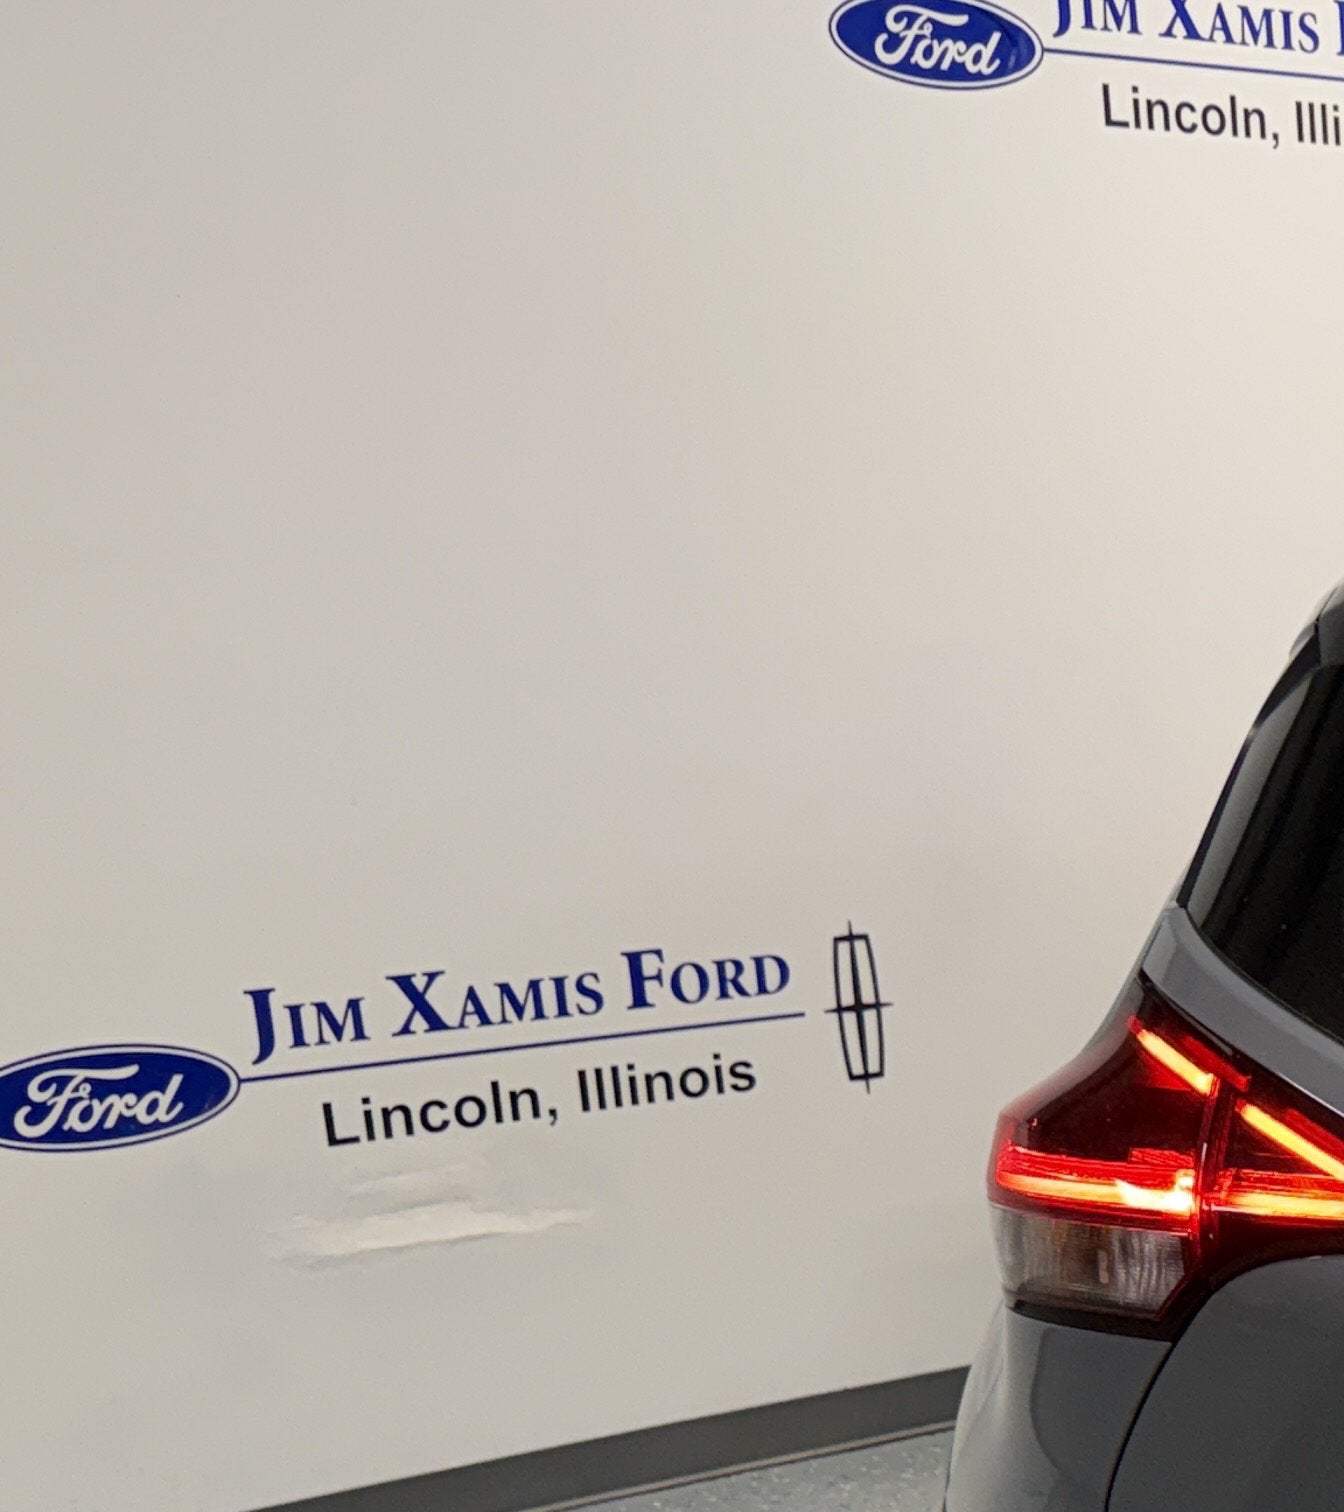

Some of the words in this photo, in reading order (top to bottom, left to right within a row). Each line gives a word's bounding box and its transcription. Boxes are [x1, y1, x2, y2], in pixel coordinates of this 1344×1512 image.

[875, 4, 1001, 76] Ford
[1158, 0, 1320, 54] XAMIS
[1102, 84, 1280, 149] Lincoln,
[243, 986, 371, 1066] JIM
[385, 969, 605, 1036] XAMIS
[620, 948, 792, 1011] FORD
[13, 1064, 184, 1139] Ford
[321, 1079, 559, 1148] Lincoln,
[578, 1054, 757, 1112] Illinois
